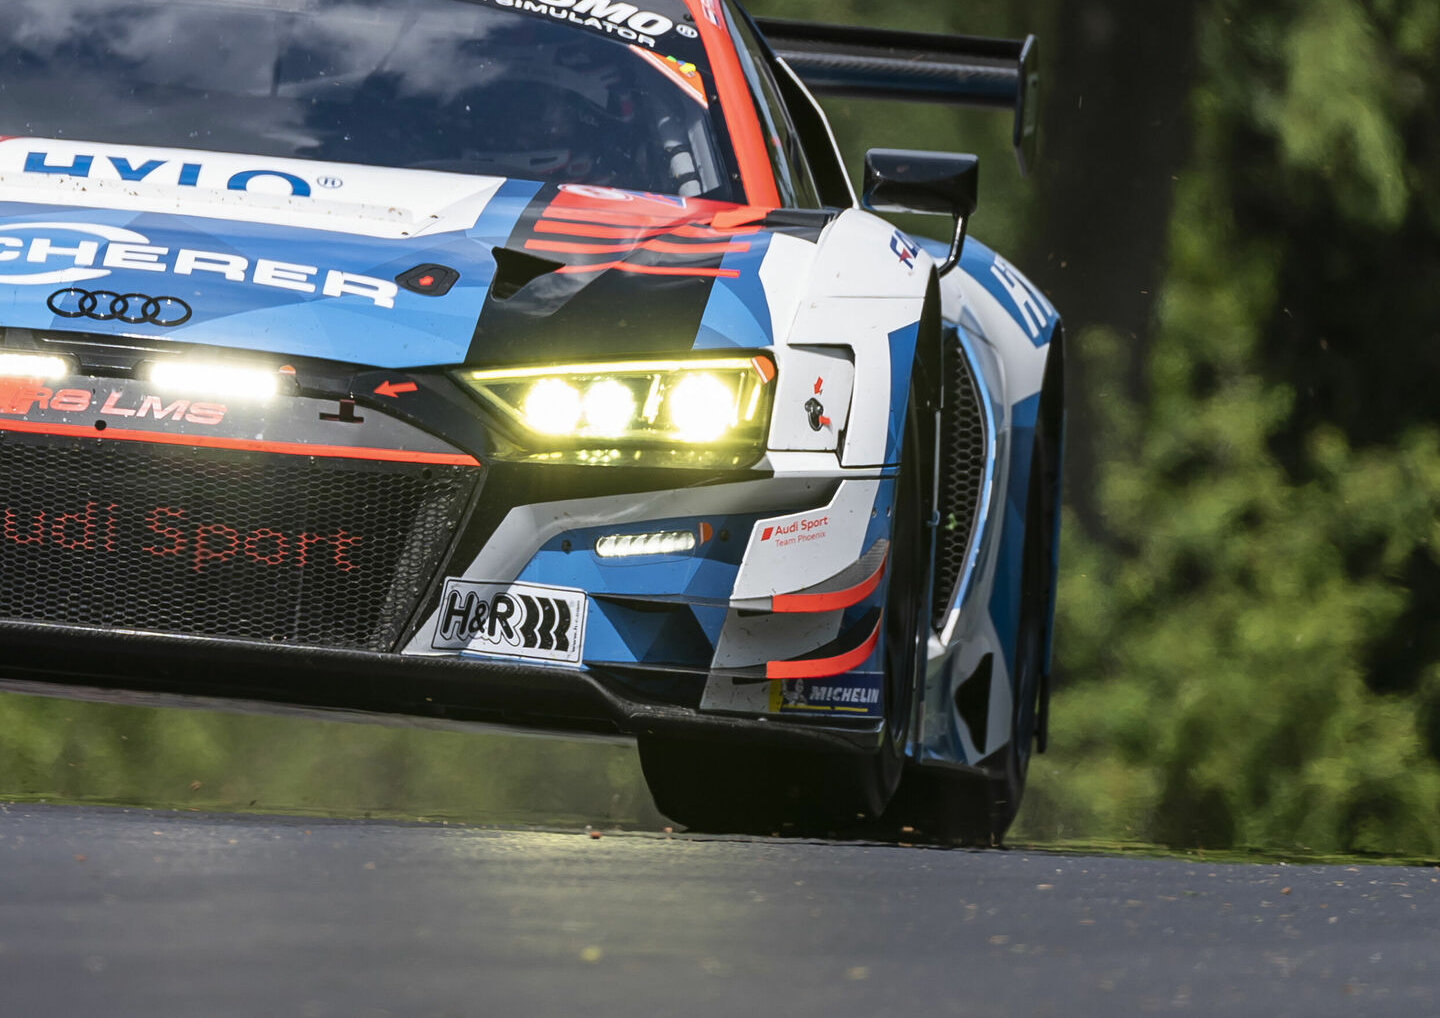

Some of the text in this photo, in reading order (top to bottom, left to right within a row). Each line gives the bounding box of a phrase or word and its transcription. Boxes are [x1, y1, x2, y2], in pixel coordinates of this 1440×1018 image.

[99, 389, 229, 426] LMS
[142, 506, 363, 574] Sport
[774, 515, 829, 536] Audi Sport
[774, 531, 826, 548] Team Phoenix
[441, 591, 520, 643] H&R
[809, 685, 880, 703] MICHELIN
